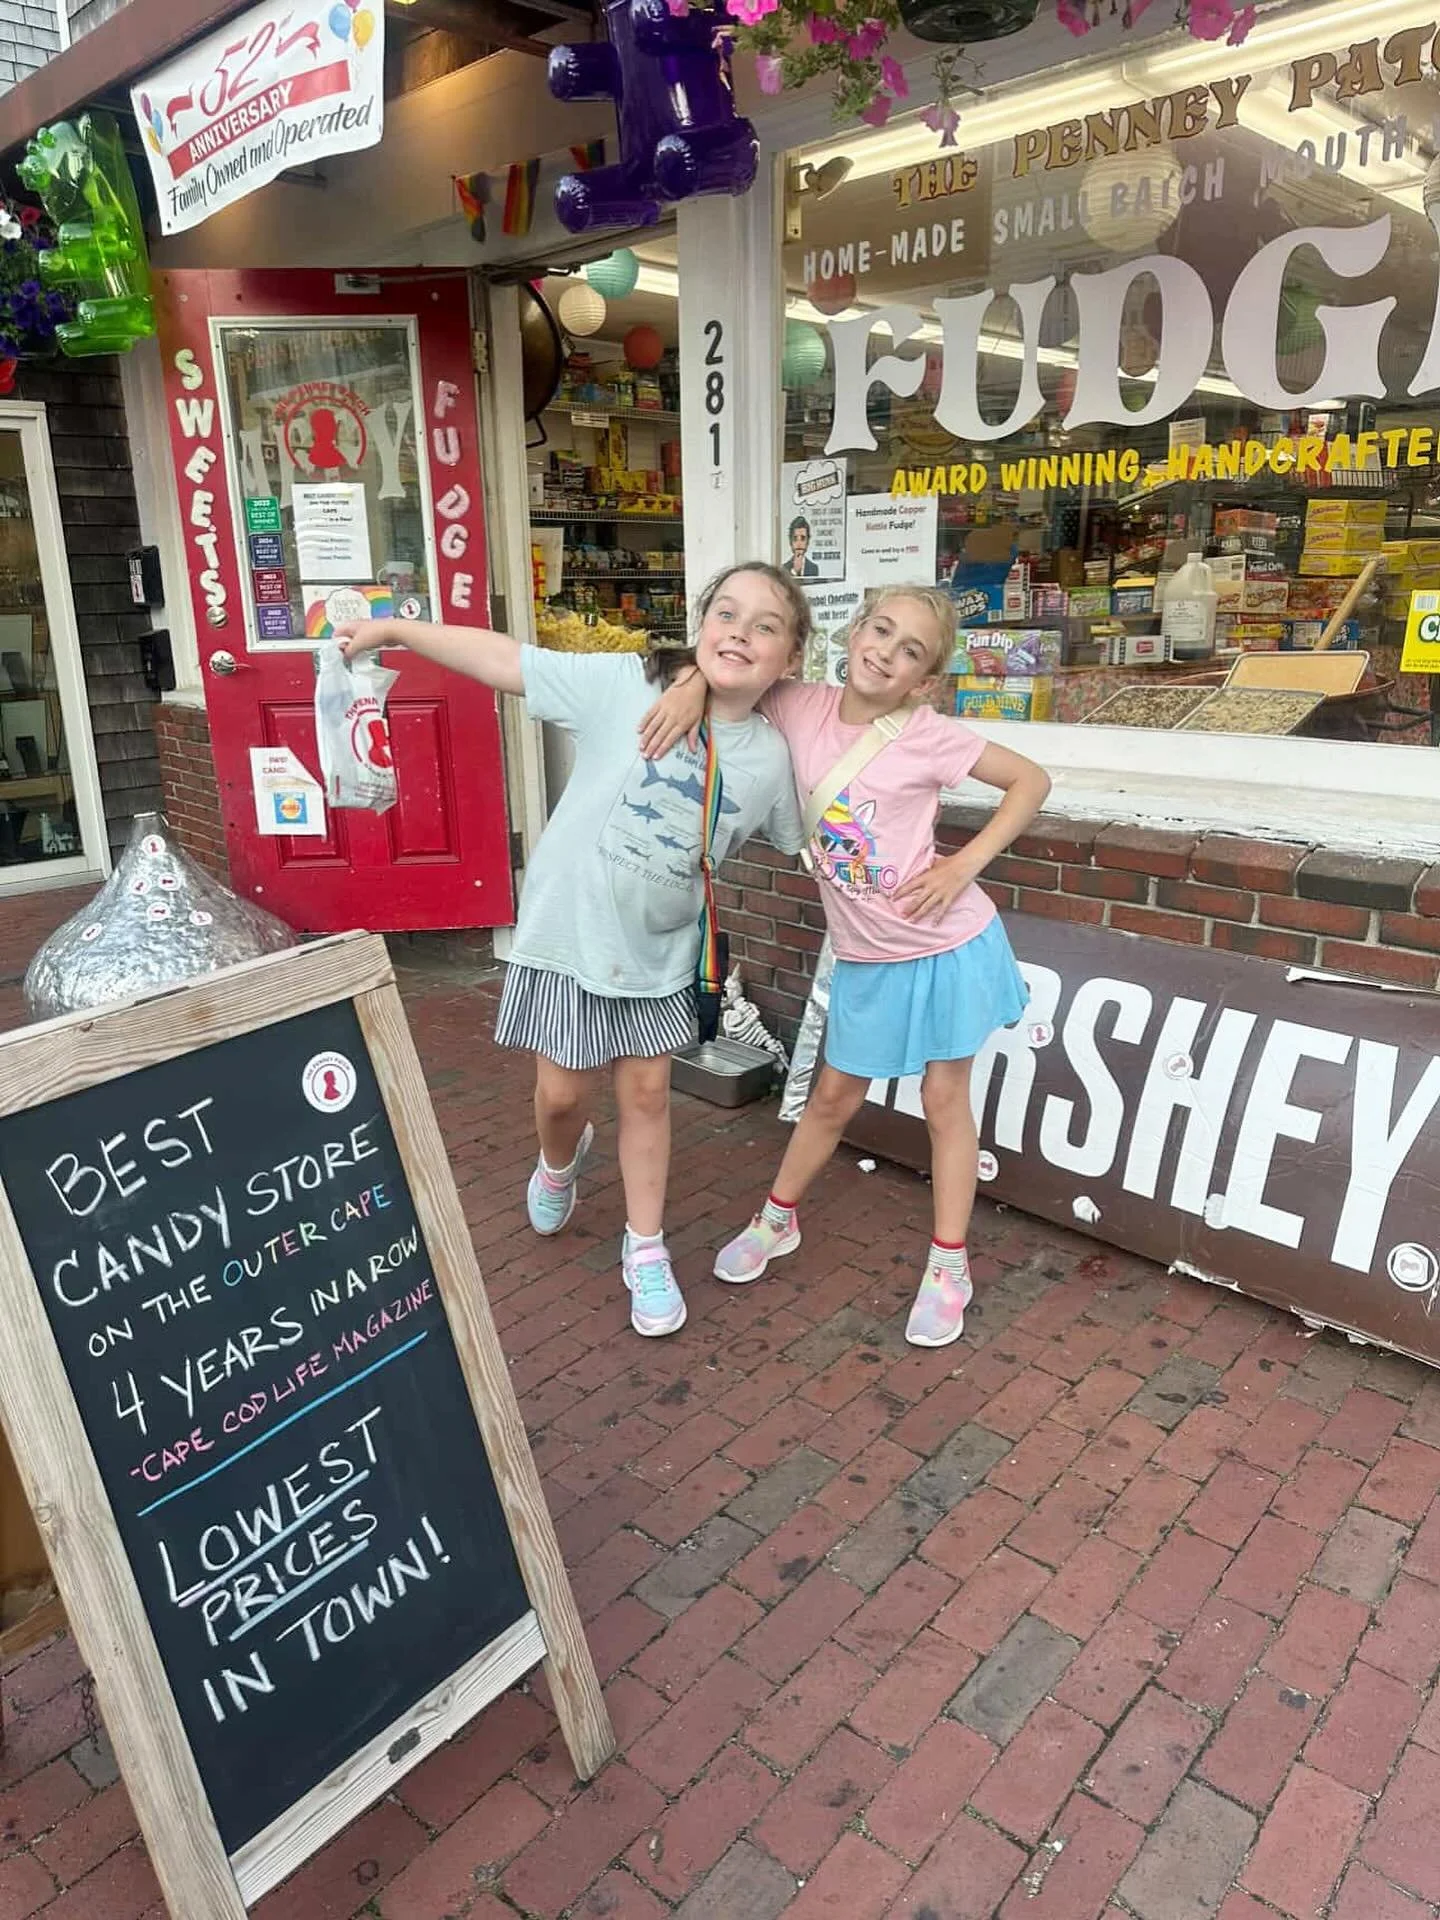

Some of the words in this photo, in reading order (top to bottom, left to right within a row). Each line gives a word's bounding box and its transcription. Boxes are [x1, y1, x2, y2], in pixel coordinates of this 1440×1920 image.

[167, 176, 207, 217] Family
[206, 152, 247, 195] Owned
[250, 131, 274, 168] and
[274, 95, 375, 155] Operated
[189, 80, 294, 164] ANNIVERSARY
[893, 152, 978, 210] THE
[1012, 75, 1252, 178] PENNEY
[1288, 22, 1440, 112] PAT
[803, 218, 966, 284] HOME-MADE
[993, 189, 1092, 245] SMALL
[1110, 157, 1225, 218] BATCH
[1260, 113, 1408, 189] MOUTH
[704, 320, 724, 466] 281
[824, 213, 1440, 456] FUDG
[175, 348, 227, 606] SWEETS
[433, 379, 474, 609] FUDGE
[855, 506, 897, 518] Handmade
[899, 504, 927, 515] Copper
[889, 519, 916, 531] Fudge!
[890, 462, 988, 499] AWARD
[1166, 428, 1440, 481] HANDCRAFTE
[966, 632, 990, 650] Fun
[991, 630, 1013, 653] Dip
[46, 1098, 214, 1216] BEST
[52, 1185, 231, 1306] CANDY
[246, 1116, 380, 1216] STORE
[88, 1317, 133, 1357] ON
[142, 1275, 212, 1325] THE
[223, 1222, 327, 1287] OUTER
[330, 1183, 393, 1232] CAPE
[112, 1370, 147, 1436] 4
[160, 1307, 303, 1419] YEARS
[310, 1280, 341, 1317] IN
[345, 1267, 368, 1298] A
[370, 1224, 418, 1284] ROW
[223, 1391, 267, 1434] COD
[273, 1353, 329, 1403] LIFE
[333, 1279, 433, 1361] MAGAZINE
[158, 1406, 381, 1603] LOWEST
[201, 1499, 378, 1646] PRICES
[203, 1651, 276, 1723] IN
[275, 1514, 451, 1662] TOWN!
